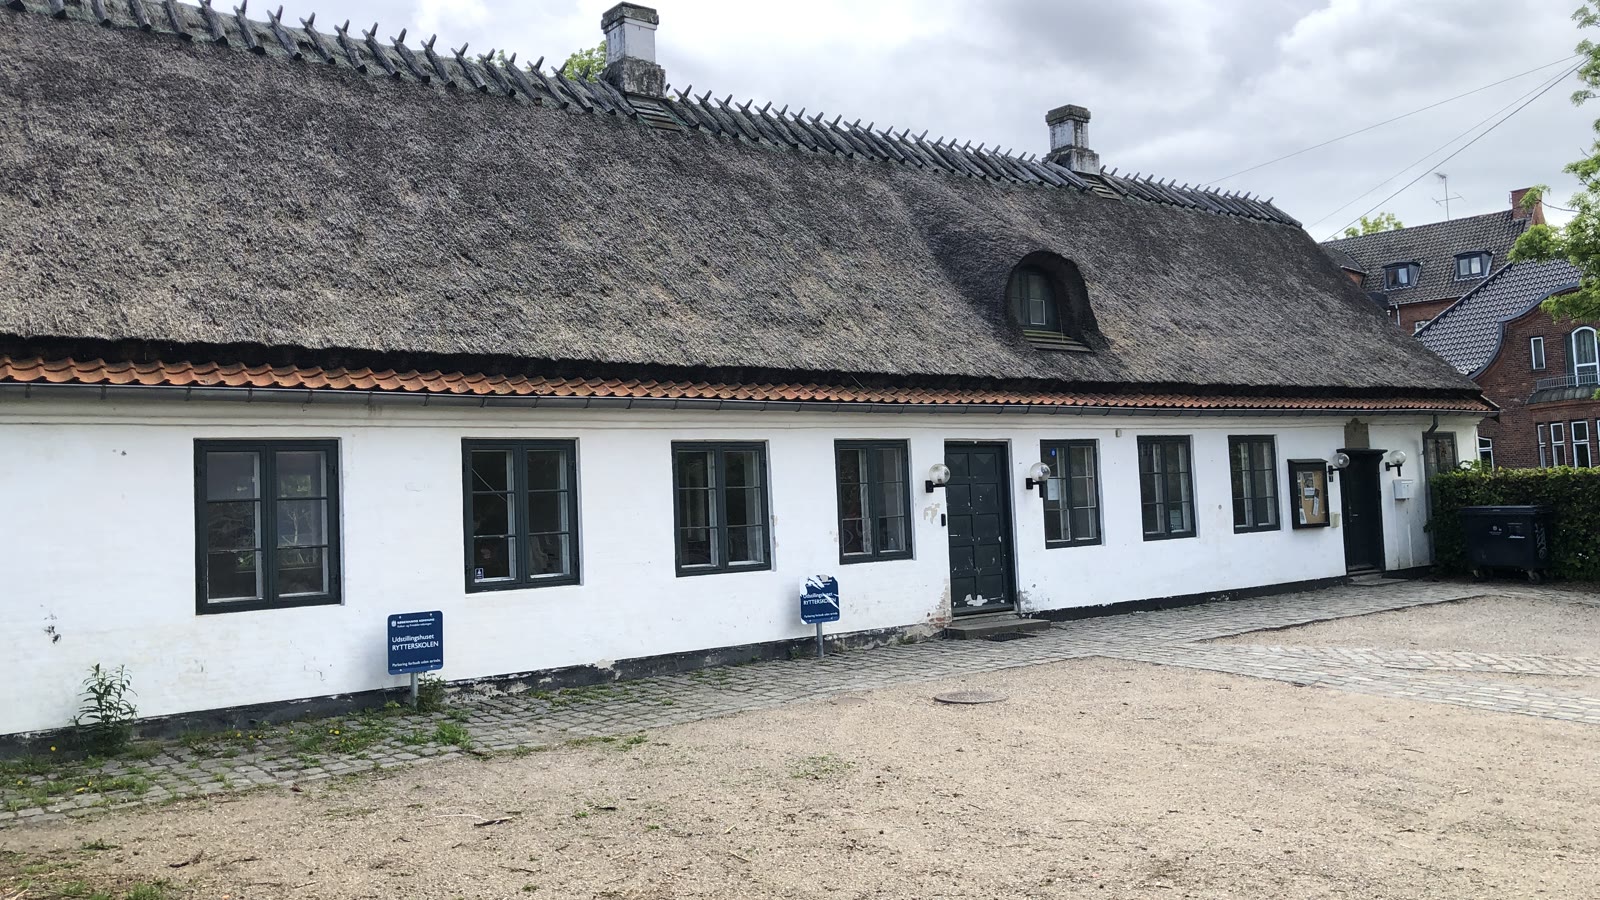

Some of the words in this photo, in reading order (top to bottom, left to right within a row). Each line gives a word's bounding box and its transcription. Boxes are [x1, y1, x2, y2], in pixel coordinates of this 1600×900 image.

[803, 597, 836, 605] RYTTERSKON
[391, 634, 434, 642] Udstillingshuset
[392, 641, 439, 651] RYTTERSKOLEN
